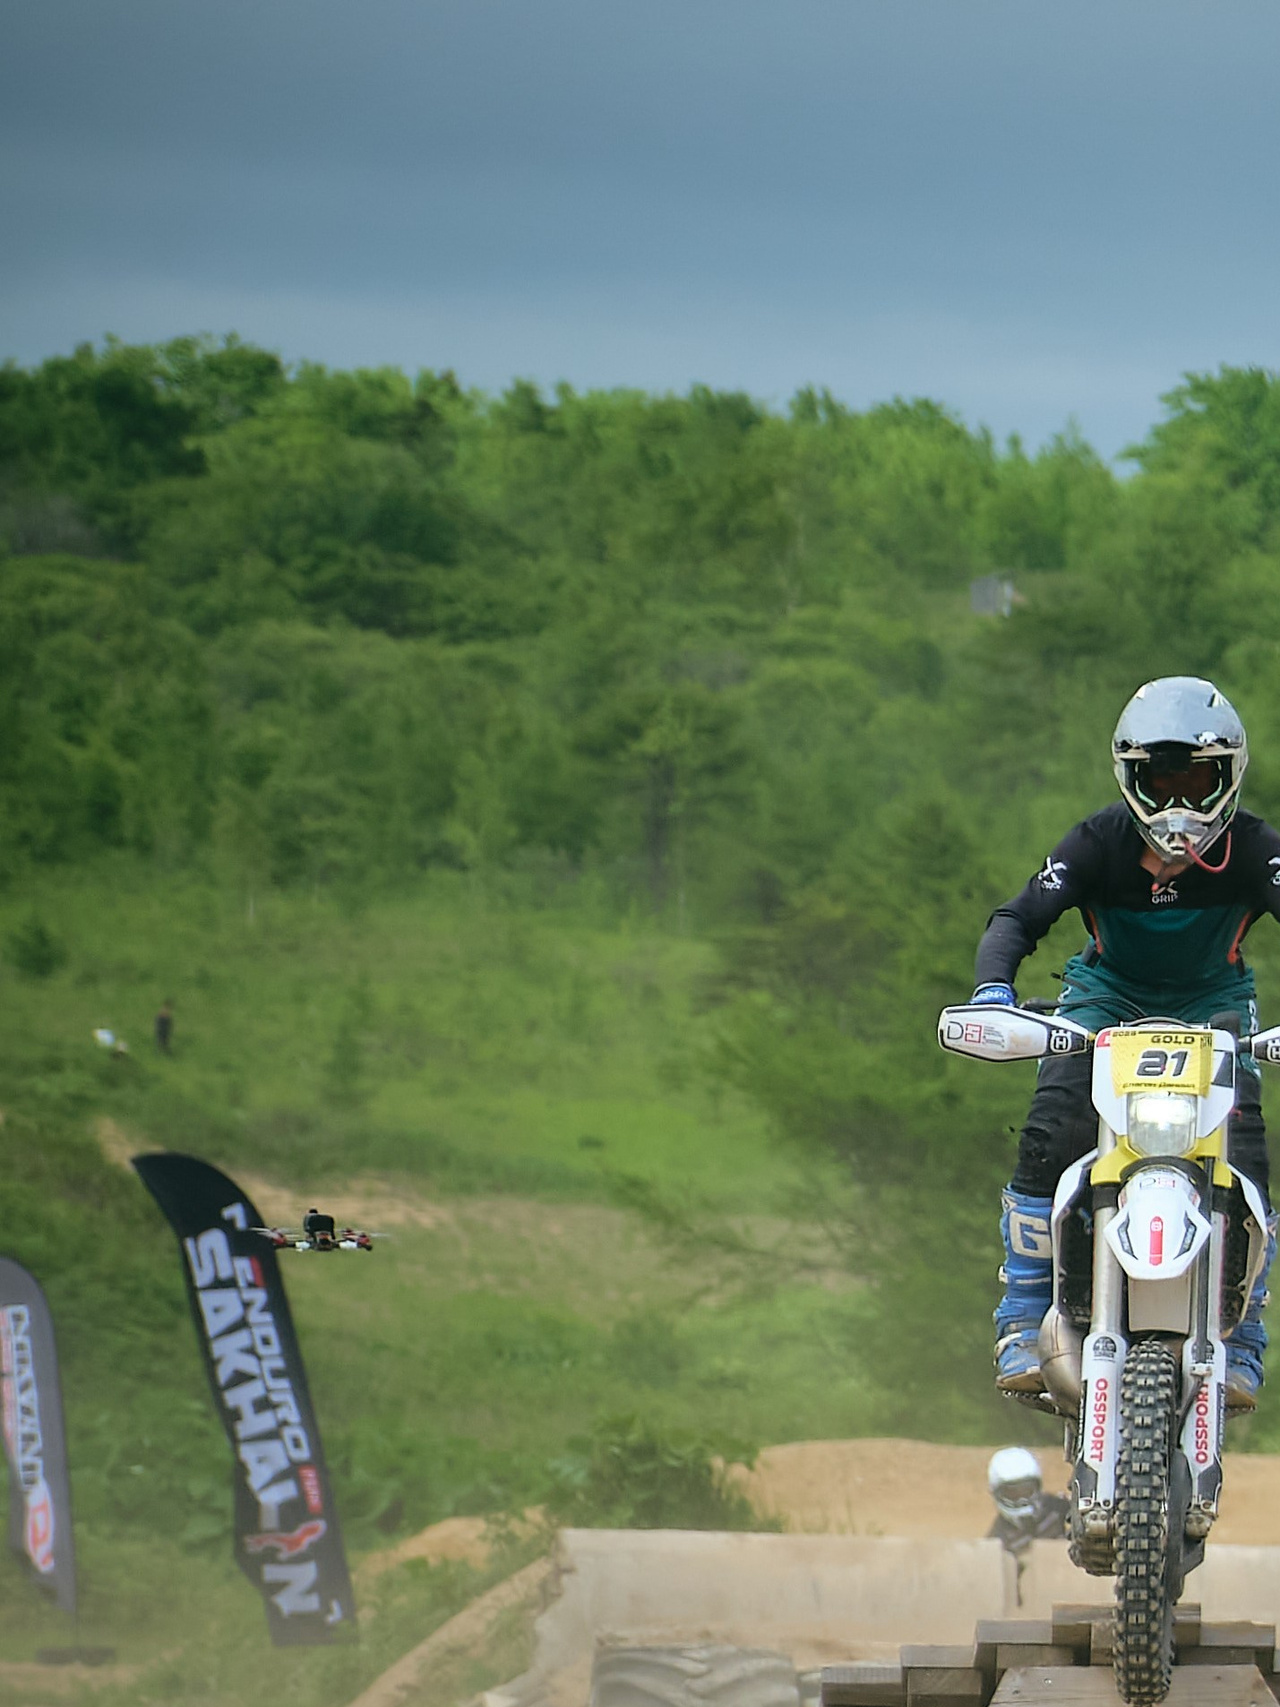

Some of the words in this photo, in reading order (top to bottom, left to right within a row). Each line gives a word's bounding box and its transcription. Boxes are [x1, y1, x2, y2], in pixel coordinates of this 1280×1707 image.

[1151, 1035, 1195, 1045] GOLD
[1136, 1050, 1188, 1077] 21
[1090, 1378, 1108, 1462] OSSPORT
